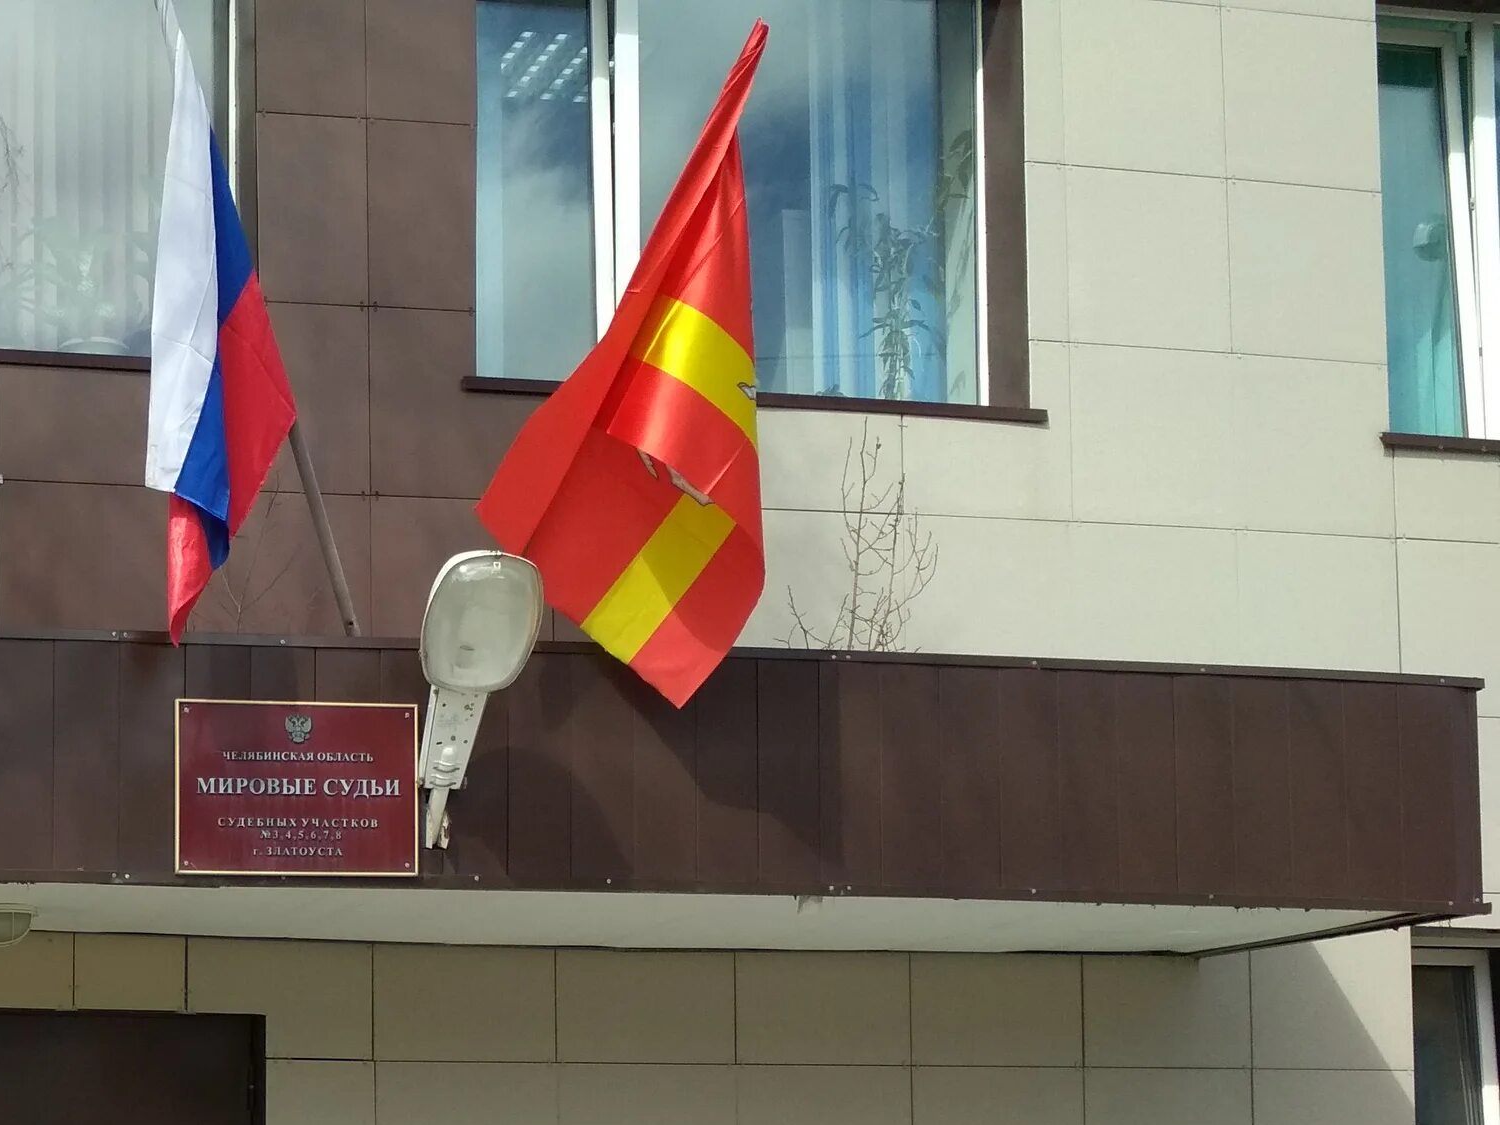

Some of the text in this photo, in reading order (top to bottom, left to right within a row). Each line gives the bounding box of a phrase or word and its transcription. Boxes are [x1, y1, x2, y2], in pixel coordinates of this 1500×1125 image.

[222, 751, 374, 762] ЧЕЛЯБИНСКАЯ ОБЛАСТЬ
[196, 777, 401, 799] МИРОВЫЕ СУДЬИ
[217, 817, 379, 829] СУДЕБНЫХ УЧАСТКОВ
[266, 847, 343, 857] ЗЛАТОУСТА
